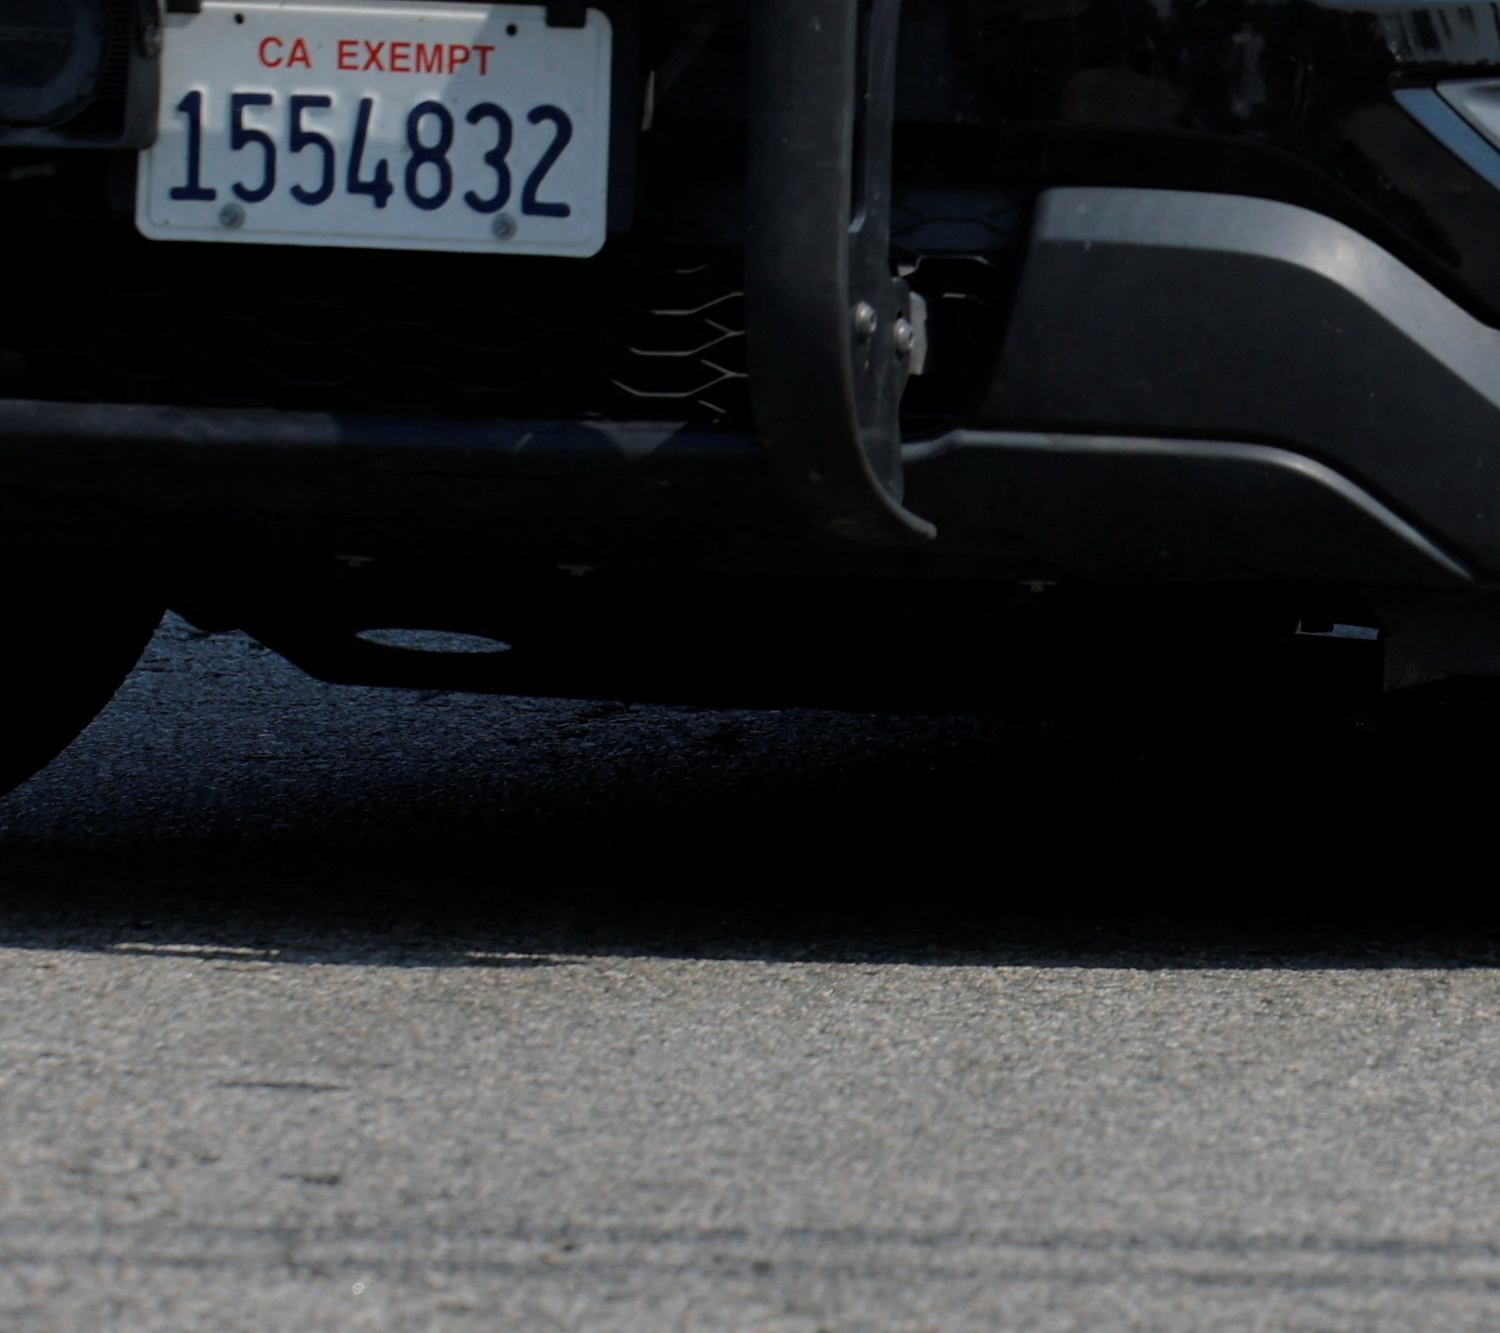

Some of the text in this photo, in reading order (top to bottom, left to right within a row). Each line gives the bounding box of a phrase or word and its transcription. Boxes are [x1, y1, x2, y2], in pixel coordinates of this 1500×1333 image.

[257, 36, 496, 76] CA EXEMPT
[170, 90, 574, 218] 1554832
